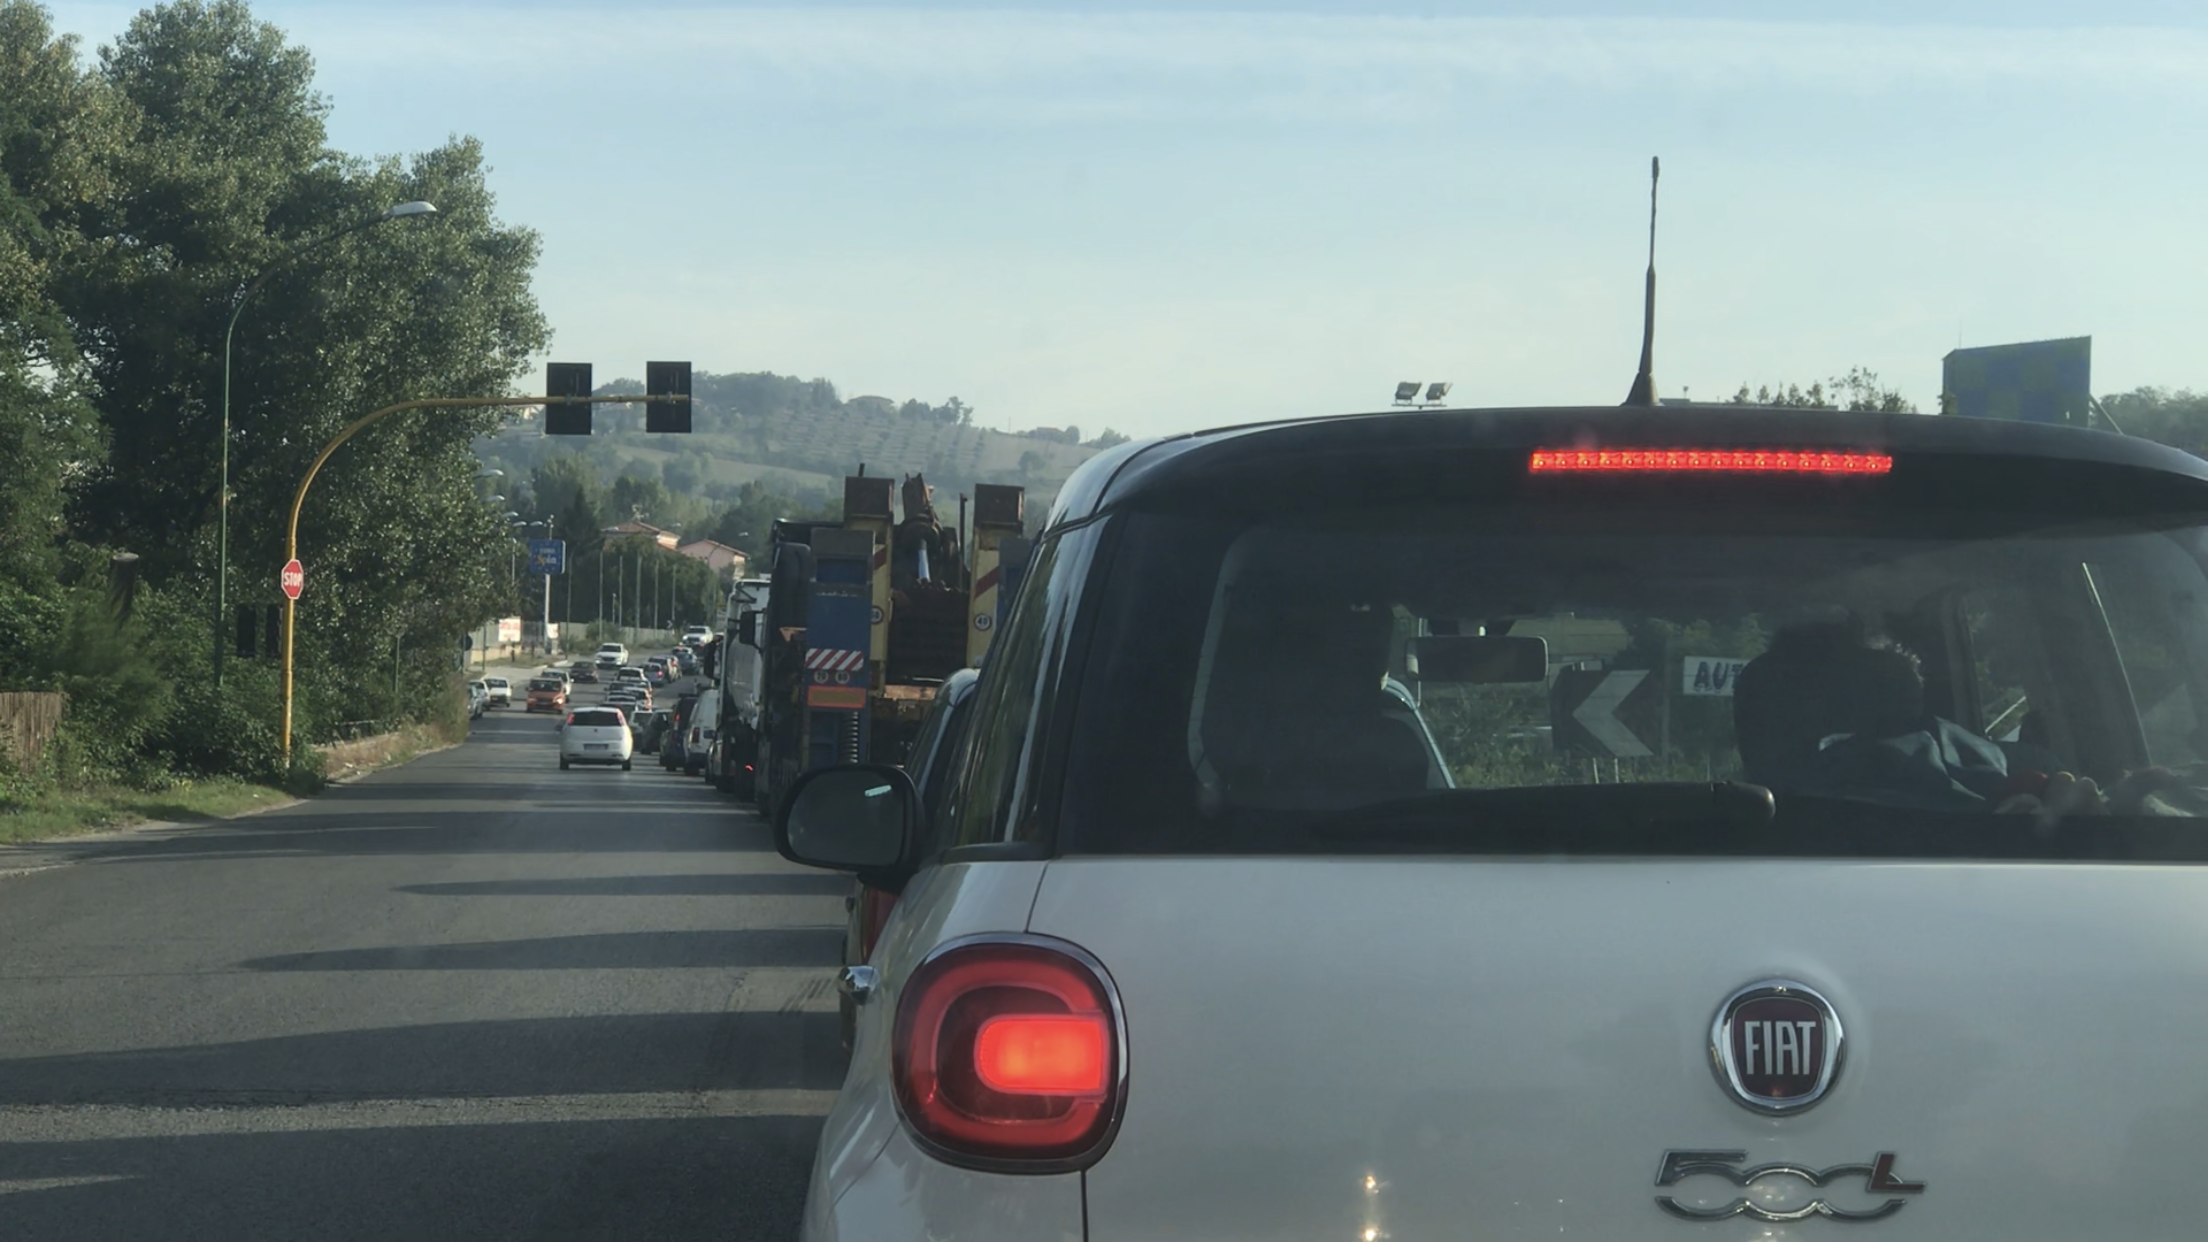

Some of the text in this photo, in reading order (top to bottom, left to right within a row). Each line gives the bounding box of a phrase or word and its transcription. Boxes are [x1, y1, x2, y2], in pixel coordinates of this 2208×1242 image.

[284, 572, 302, 587] STOP
[1744, 1021, 1816, 1075] FIAT
[1655, 1149, 1926, 1222] 500L
